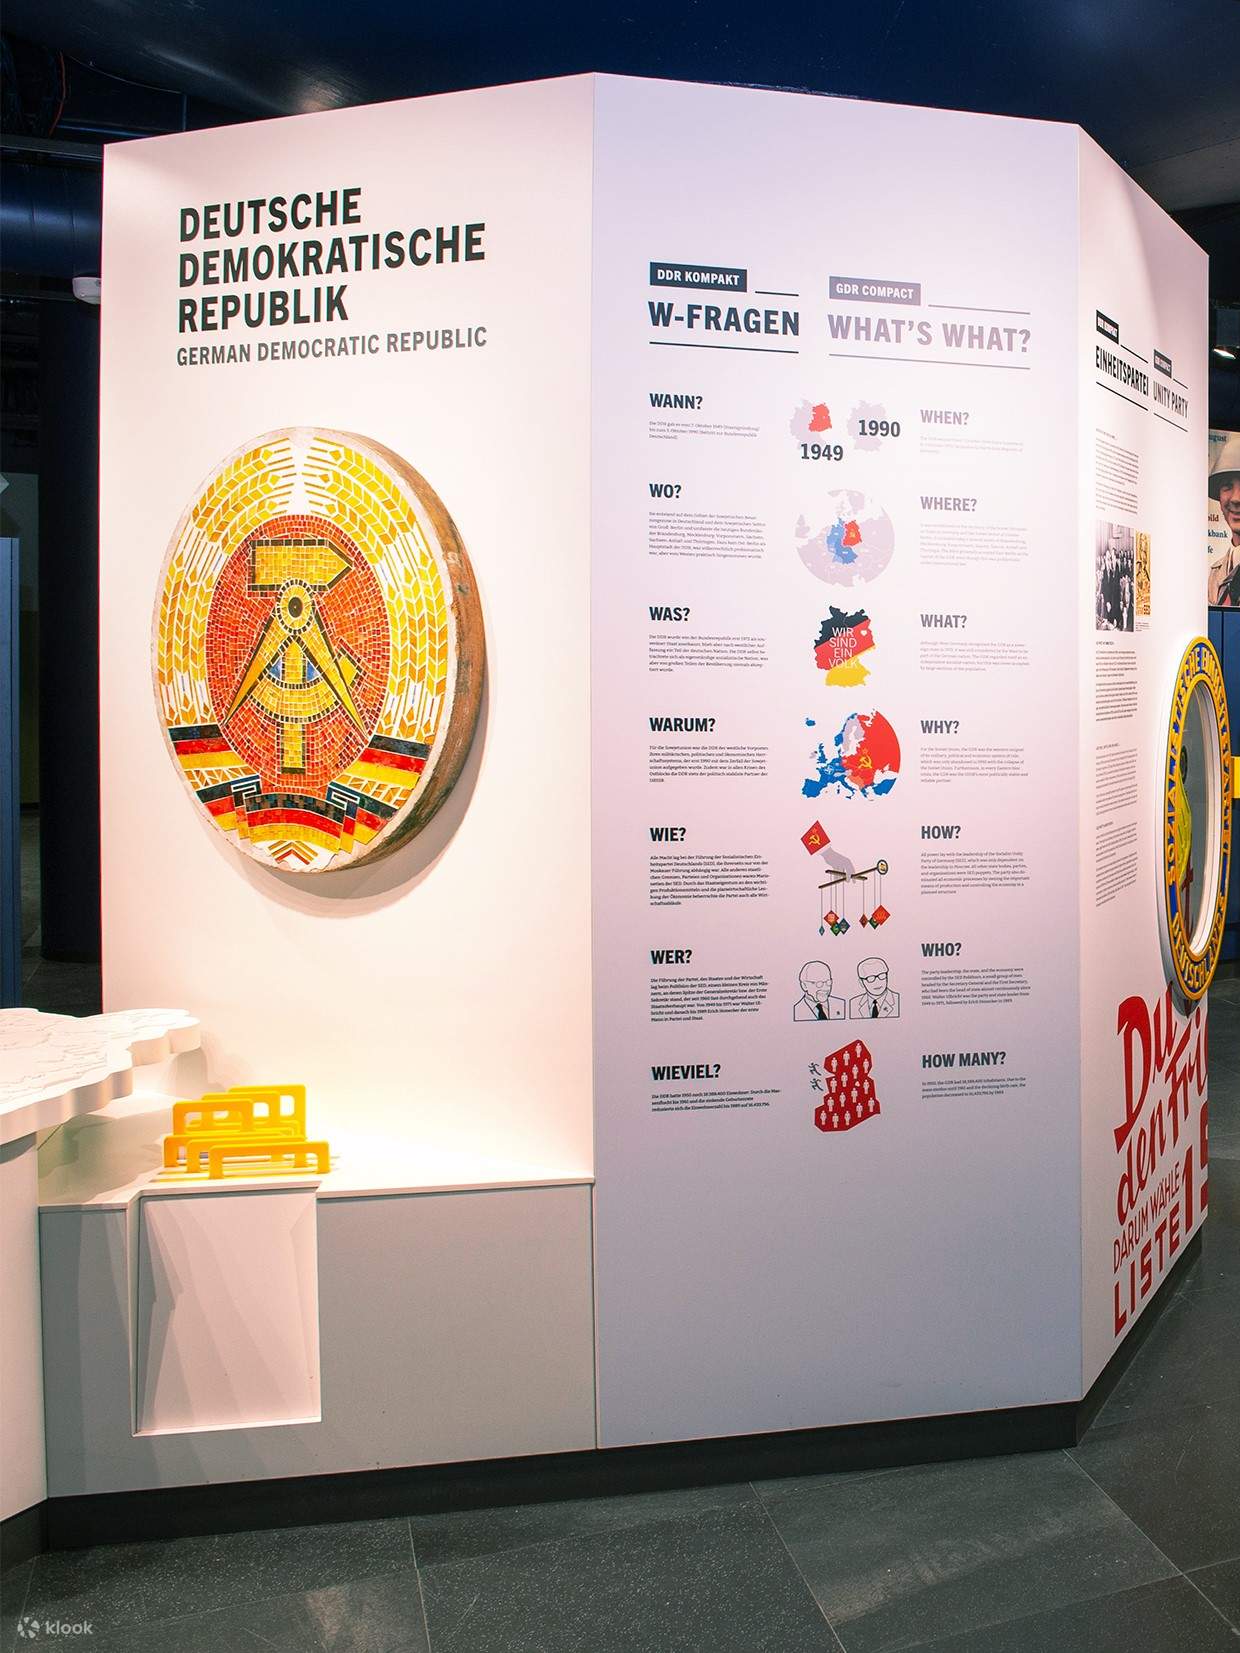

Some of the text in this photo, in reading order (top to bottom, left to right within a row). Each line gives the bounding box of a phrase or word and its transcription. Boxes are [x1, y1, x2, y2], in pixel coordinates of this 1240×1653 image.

[179, 187, 362, 242] DEUTSCHE
[179, 222, 486, 288] DEMOKRATISCHE
[656, 268, 740, 286] DDR KOMPAKT
[835, 282, 914, 299] GDR COMPACT
[178, 284, 349, 333] REPUBLIK
[648, 301, 800, 337] W-FRAGEN
[176, 326, 488, 367] GERMAN DEMOCRATIC REPUBLIC
[942, 322, 1031, 353] WHAT?
[1096, 345, 1149, 397] EINHEITSPARTEI
[649, 392, 703, 410] WANN?
[1153, 380, 1189, 418] UNITY PARTY
[920, 408, 970, 426] WHEN?
[858, 419, 901, 438] 1990
[800, 442, 844, 461] 1949
[649, 482, 682, 499] WO?
[920, 495, 978, 513] WHERE?
[649, 606, 691, 622] WAS?
[920, 613, 968, 629] WHAT?
[831, 627, 855, 638] WIR
[828, 637, 858, 649] SIND
[833, 648, 853, 659] EIN
[828, 658, 860, 669] VOLK
[649, 717, 716, 733] WARUM?
[920, 719, 960, 735] WHY?
[650, 827, 687, 842] WIE?
[921, 825, 962, 840] HOW?
[650, 948, 692, 964] WER?
[921, 942, 962, 957] WHO?
[921, 1050, 1007, 1069] HOW MANY?
[651, 1063, 721, 1081] WIEVIEL?
[1113, 1160, 1181, 1275] DARUM WÄHLE
[1114, 1200, 1181, 1339] LISTE
